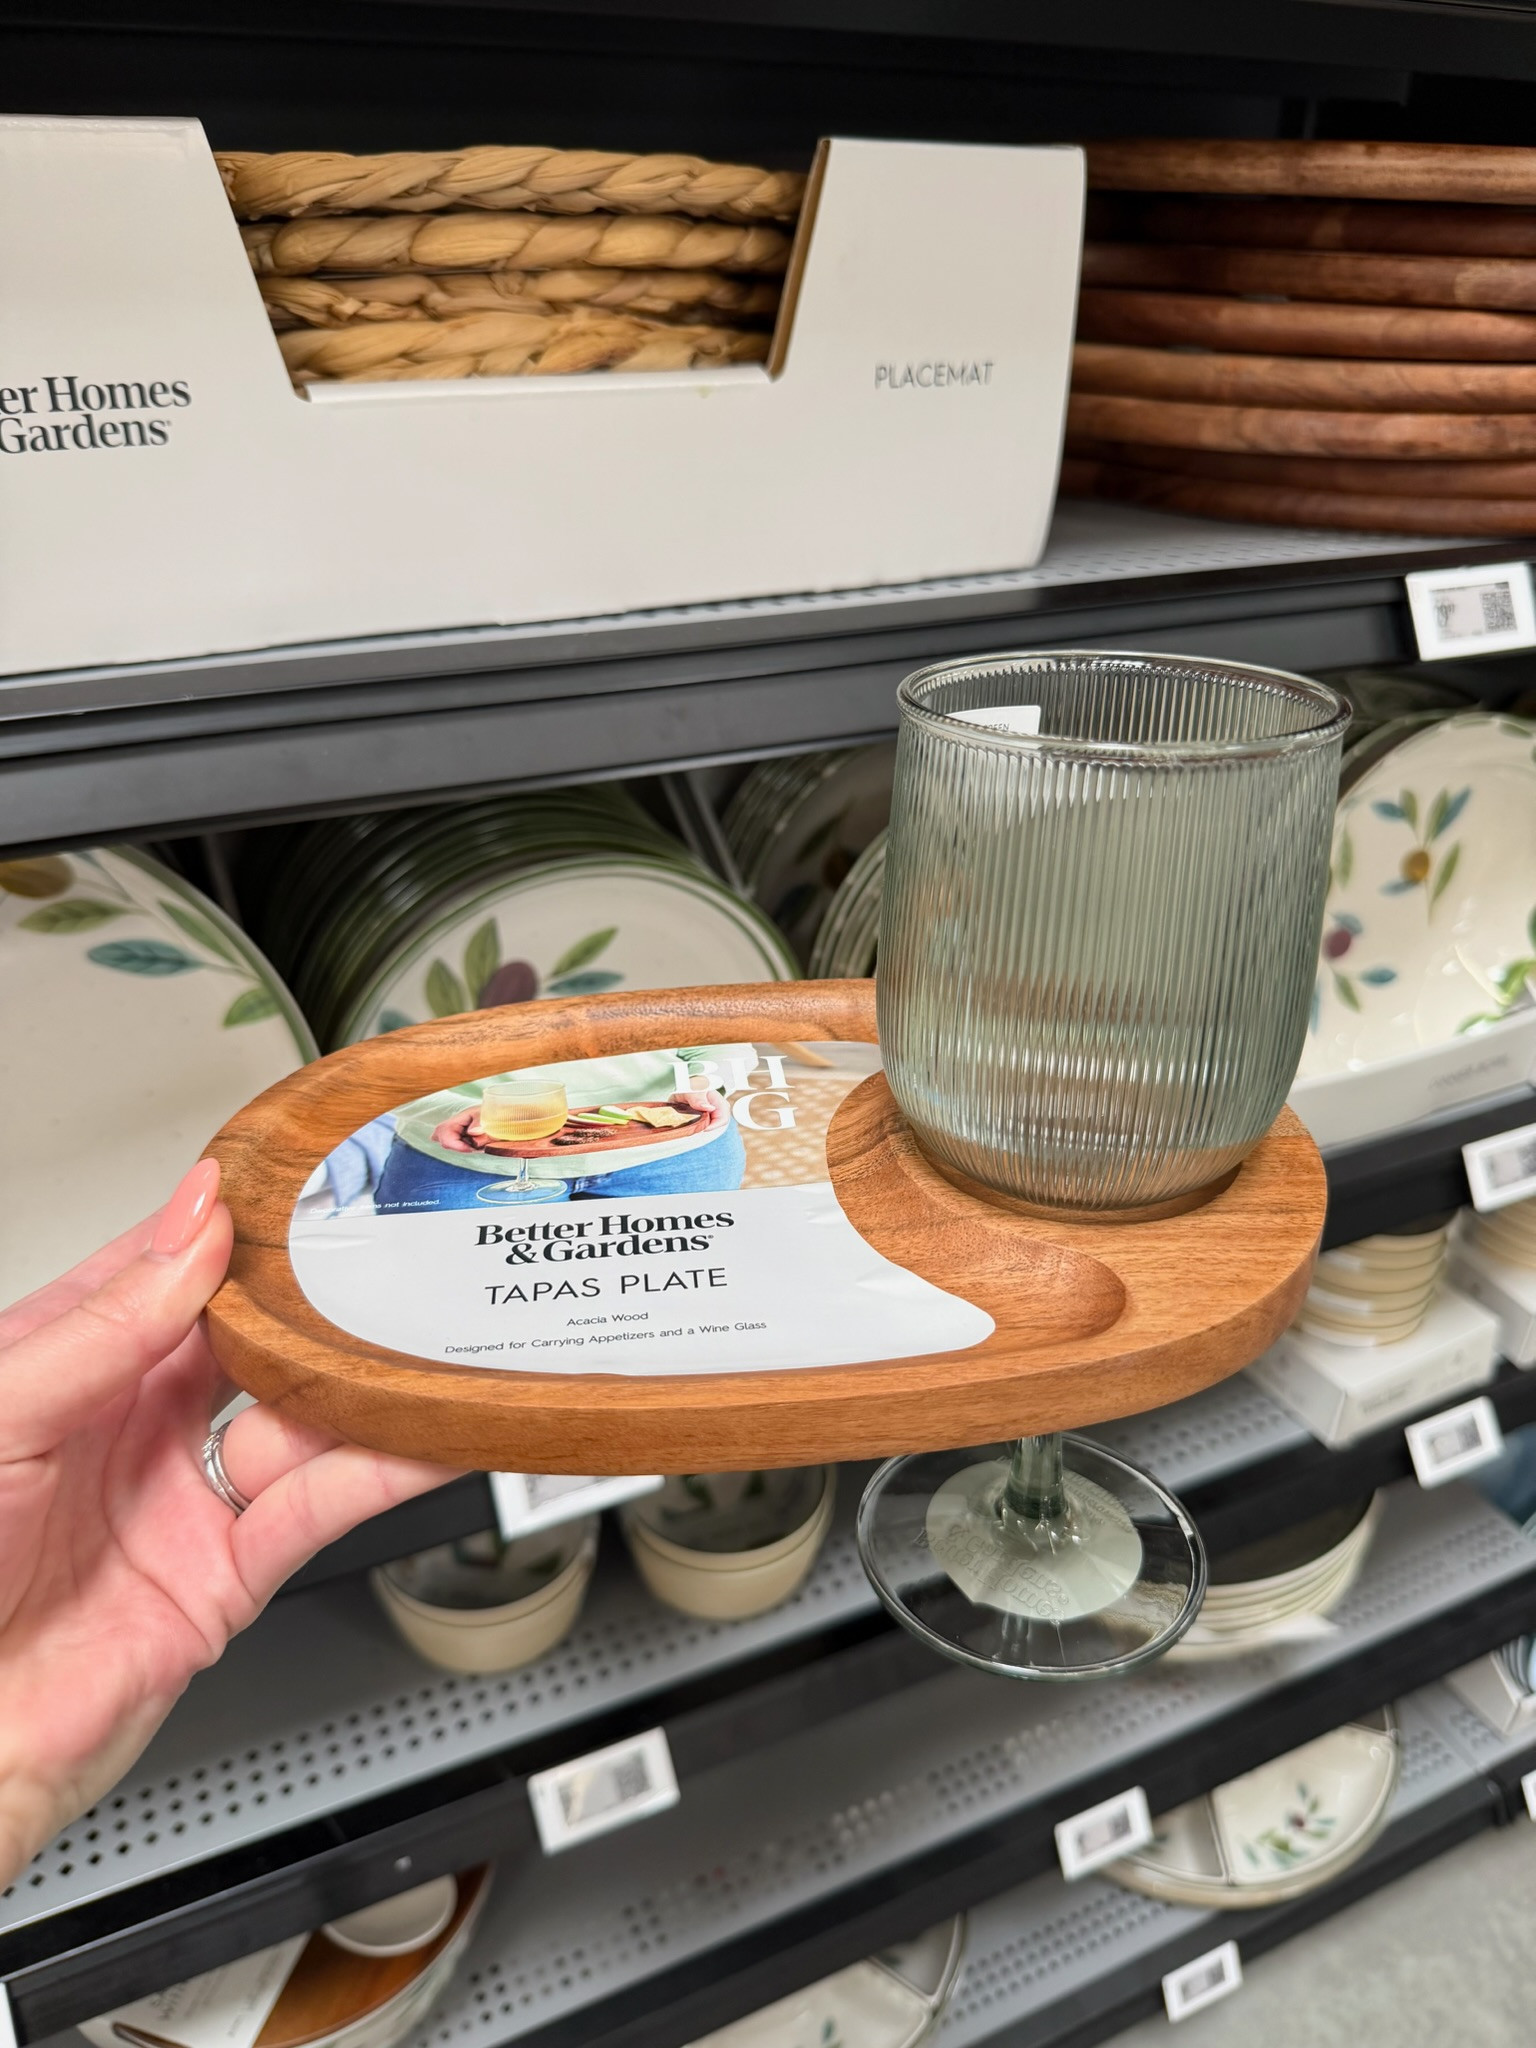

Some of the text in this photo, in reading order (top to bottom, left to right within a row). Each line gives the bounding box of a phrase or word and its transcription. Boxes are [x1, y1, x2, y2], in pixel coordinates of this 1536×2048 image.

[874, 360, 994, 389] PLACEMAT
[42, 376, 192, 412] Homes
[474, 1212, 735, 1246] Better Homes
[505, 1243, 539, 1265] &
[485, 1267, 728, 1305] TAPAS PLATE
[566, 1312, 649, 1327] Acacia Wood
[444, 1343, 504, 1354] Designed
[508, 1341, 527, 1349] for
[531, 1336, 585, 1347] Carrying
[588, 1330, 655, 1344] Appetizers
[659, 1328, 683, 1337] and
[699, 1324, 730, 1333] Wine
[734, 1320, 767, 1330] Glass
